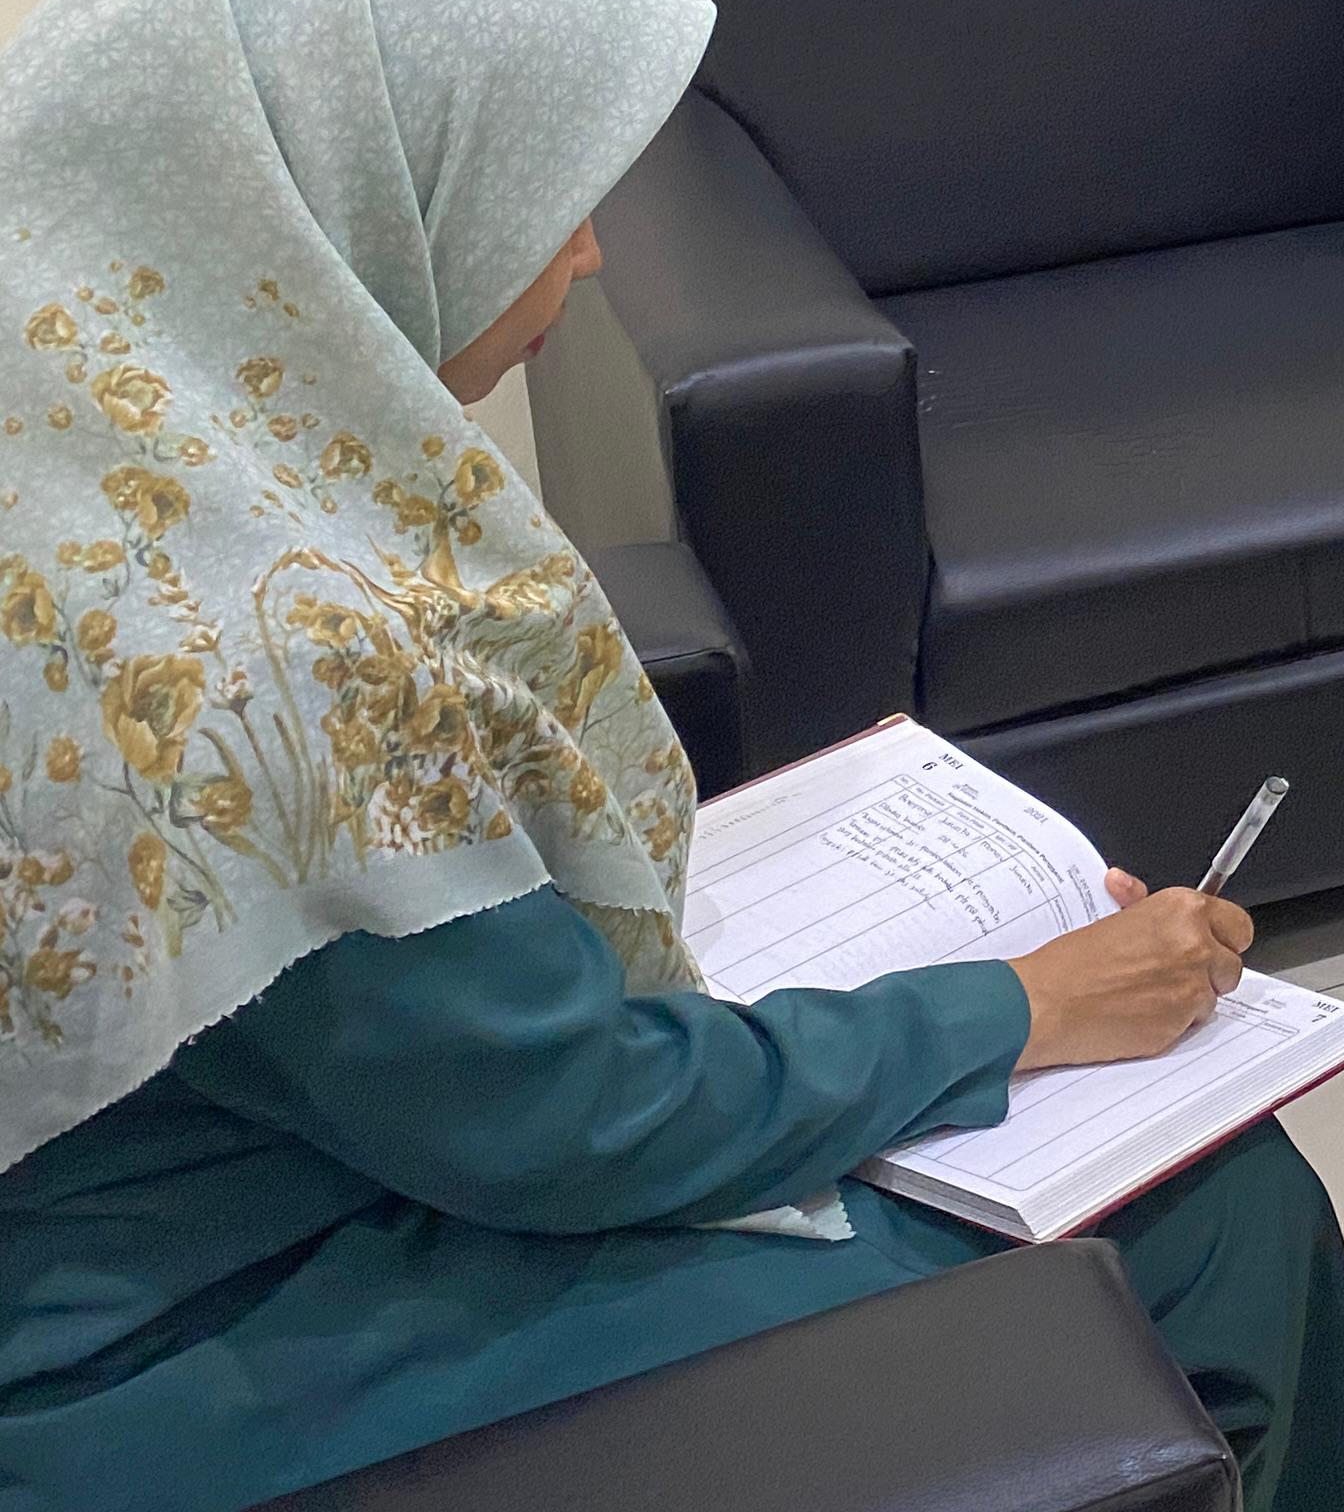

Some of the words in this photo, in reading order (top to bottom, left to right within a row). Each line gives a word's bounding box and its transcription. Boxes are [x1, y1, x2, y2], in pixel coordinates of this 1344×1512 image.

[922, 762, 938, 770] 6
[939, 753, 964, 770] MEI
[1312, 1001, 1340, 1013] MEI
[1312, 1014, 1326, 1022] 7
